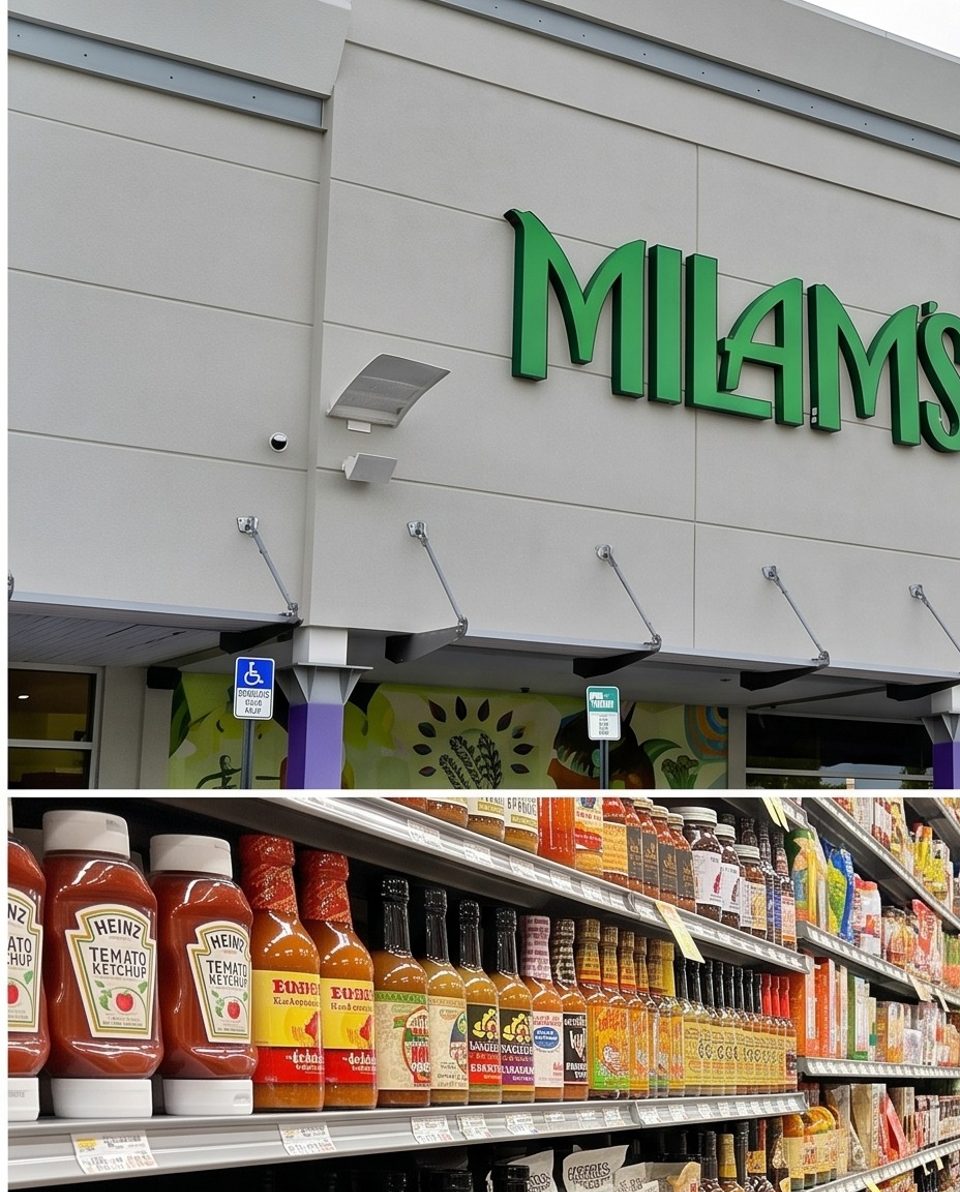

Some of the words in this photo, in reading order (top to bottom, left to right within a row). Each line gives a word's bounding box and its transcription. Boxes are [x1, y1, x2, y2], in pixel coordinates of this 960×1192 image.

[94, 918, 141, 939] HEINZ
[210, 934, 245, 953] HEINZ
[89, 947, 146, 966] TEMATO
[92, 962, 147, 979] KETCHUP
